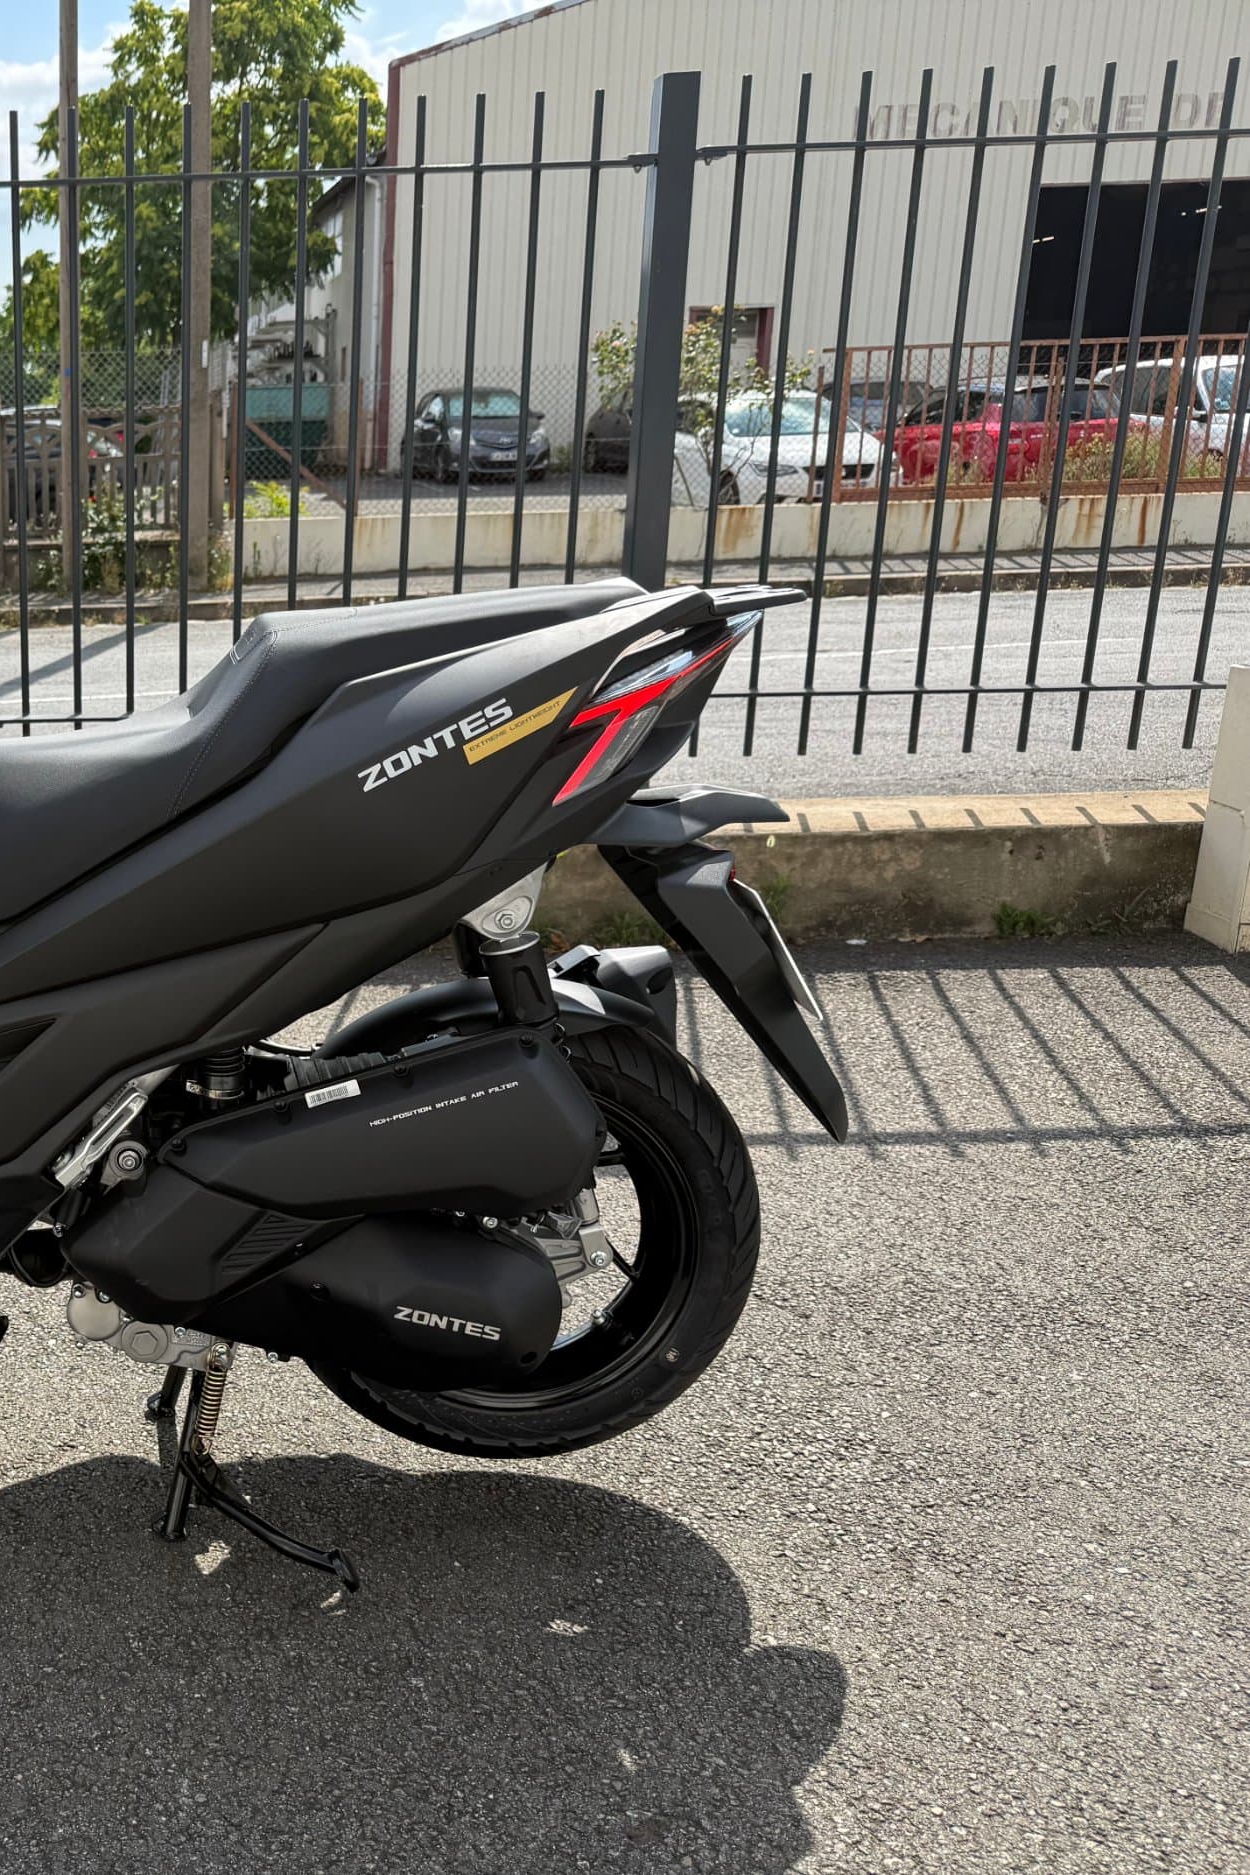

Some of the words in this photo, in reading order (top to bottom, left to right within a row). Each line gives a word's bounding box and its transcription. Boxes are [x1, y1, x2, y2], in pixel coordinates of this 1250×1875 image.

[358, 698, 514, 792] ZONTES
[469, 729, 508, 752] EXTREME
[509, 701, 561, 731] LIGHTWEIGHT
[369, 1105, 433, 1128] HIGH-POSITION
[435, 1096, 467, 1109] INTAKE
[471, 1091, 485, 1099] AIR
[488, 1081, 519, 1094] FILTER
[394, 1306, 501, 1341] ZONTES
